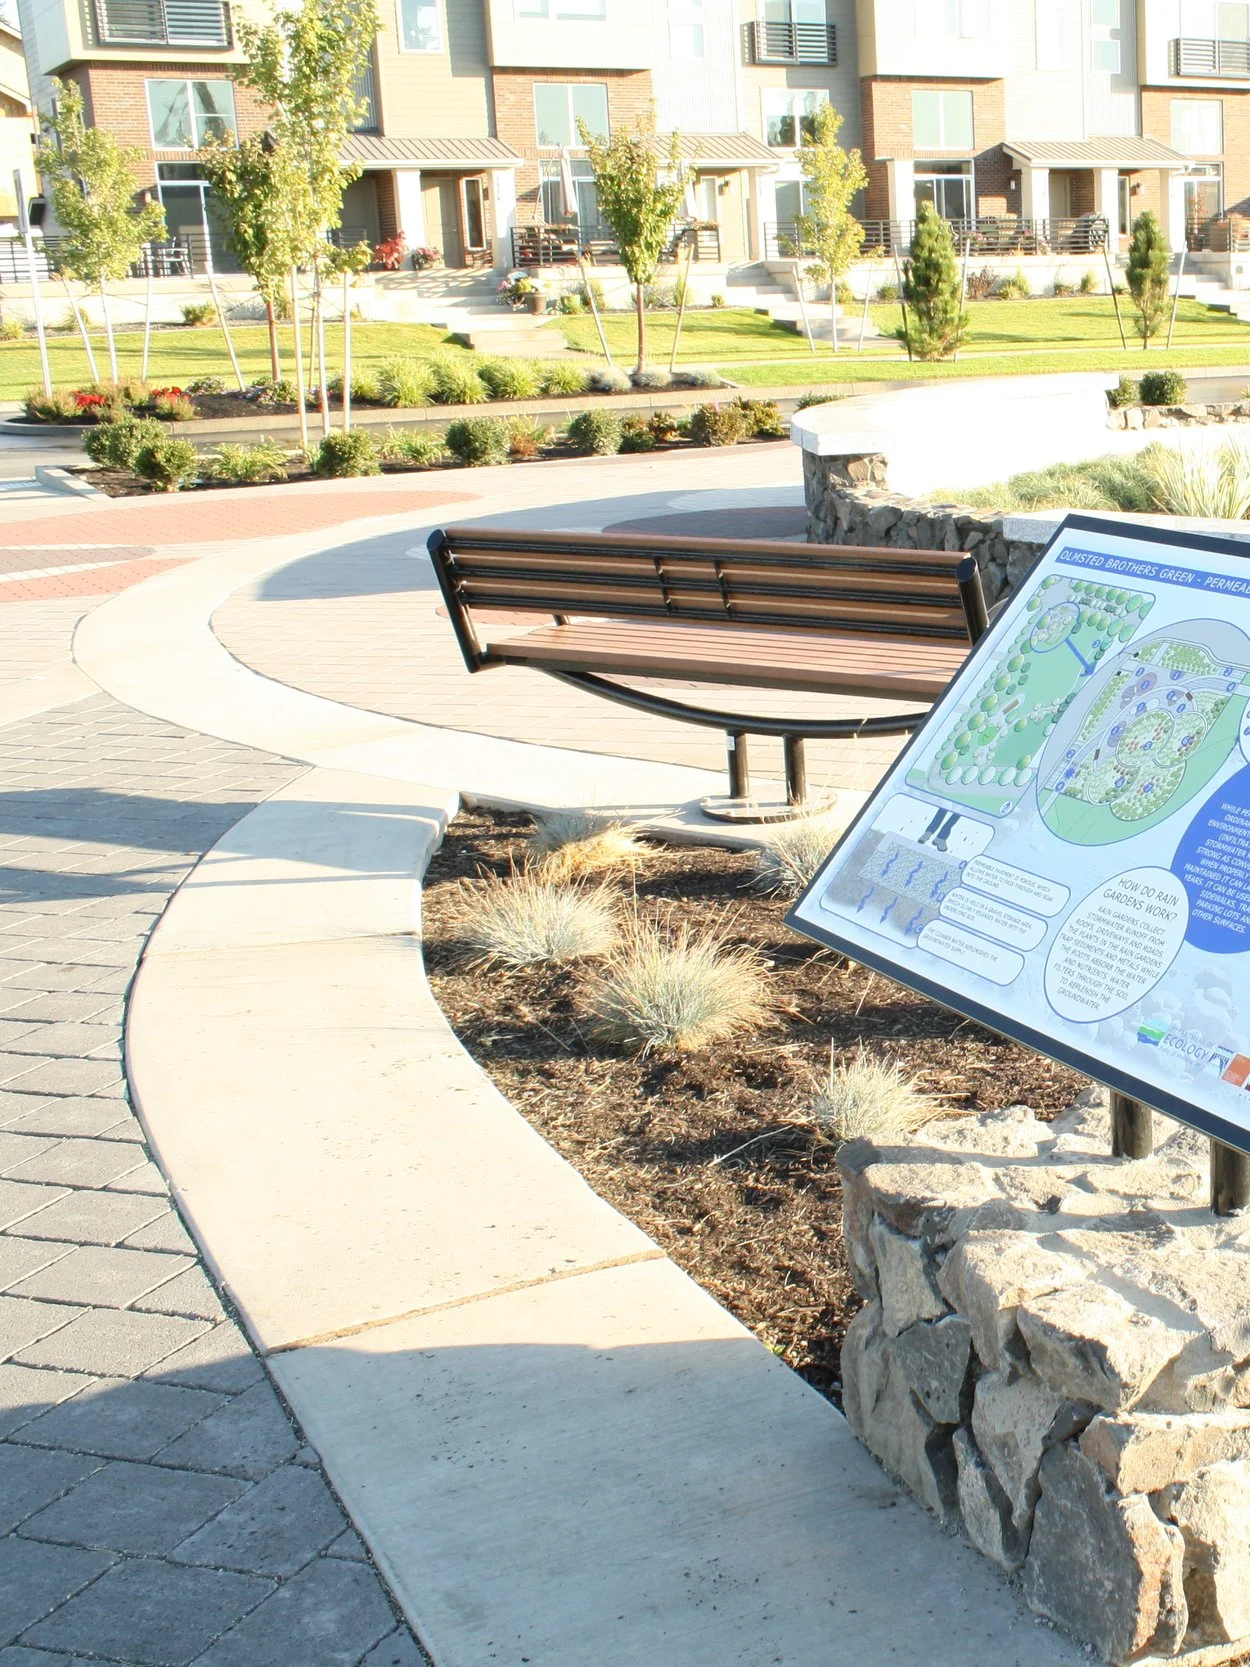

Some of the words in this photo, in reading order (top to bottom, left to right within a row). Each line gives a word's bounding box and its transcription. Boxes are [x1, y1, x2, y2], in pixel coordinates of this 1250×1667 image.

[1058, 550, 1105, 567] OLMSTED
[1103, 558, 1159, 576] BROTHERS
[1157, 568, 1196, 583] GREEN
[1220, 803, 1241, 814] WHILE
[1195, 846, 1222, 860] STRONG
[1220, 854, 1231, 863] AS
[1204, 839, 1247, 858] STORMWATER
[1182, 863, 1222, 881] MAINTAINED
[1220, 876, 1229, 884] IT
[1227, 878, 1243, 888] CAN
[1198, 858, 1219, 870] WHEN
[1217, 864, 1250, 880] PROPERLY
[1117, 877, 1141, 893] HOW
[1139, 885, 1156, 898] DO
[1154, 890, 1180, 907] RAIN
[1182, 873, 1205, 886] YEARS.
[1204, 881, 1213, 889] IT
[1211, 883, 1226, 893] CAN
[1224, 888, 1236, 897] BE
[1101, 887, 1145, 911] GARDENS
[1142, 903, 1178, 923] WORK?
[1195, 899, 1224, 914] PARKING
[1222, 908, 1240, 920] LOTS
[1086, 912, 1125, 932] STORMWATER
[1123, 927, 1148, 941] RUNOFF
[1146, 935, 1165, 947] FROM
[1096, 905, 1112, 916] RAIN
[1110, 911, 1140, 926] GARDENS
[1138, 921, 1165, 936] COLLECT
[1190, 908, 1213, 921] OTHER
[1211, 916, 1247, 934] SURFACES.
[1066, 926, 1079, 935] THE
[1077, 930, 1100, 944] PLANTS
[1098, 938, 1107, 947] IN
[1106, 942, 1120, 951] THE
[1117, 946, 1134, 957] RAIN
[1133, 952, 1163, 969] GARDENS
[1095, 926, 1129, 944] DRIVEWAYS
[1127, 939, 1142, 950] AND
[1058, 933, 1073, 944] TRAP
[1071, 939, 1105, 956] SEDIMENTS
[1103, 951, 1117, 962] AND
[1116, 957, 1140, 971] METALS
[1138, 966, 1160, 979] WHILE
[1058, 944, 1071, 953] THE
[1070, 948, 1091, 961] ROOTS
[1089, 956, 1114, 971] ABSORB
[1113, 966, 1126, 976] THE
[1124, 971, 1147, 985] WATER
[1052, 963, 1076, 977] FILTERS
[1074, 972, 1103, 989] THROUGH
[1101, 984, 1115, 994] THE
[1113, 989, 1130, 1000] SOIL
[1062, 956, 1077, 967] AND
[1108, 975, 1130, 989] WATER
[1058, 976, 1069, 985] TO
[1067, 980, 1099, 998] REPLENISH
[1097, 993, 1111, 1004] THE
[1162, 1033, 1210, 1061] ECOLOGY
